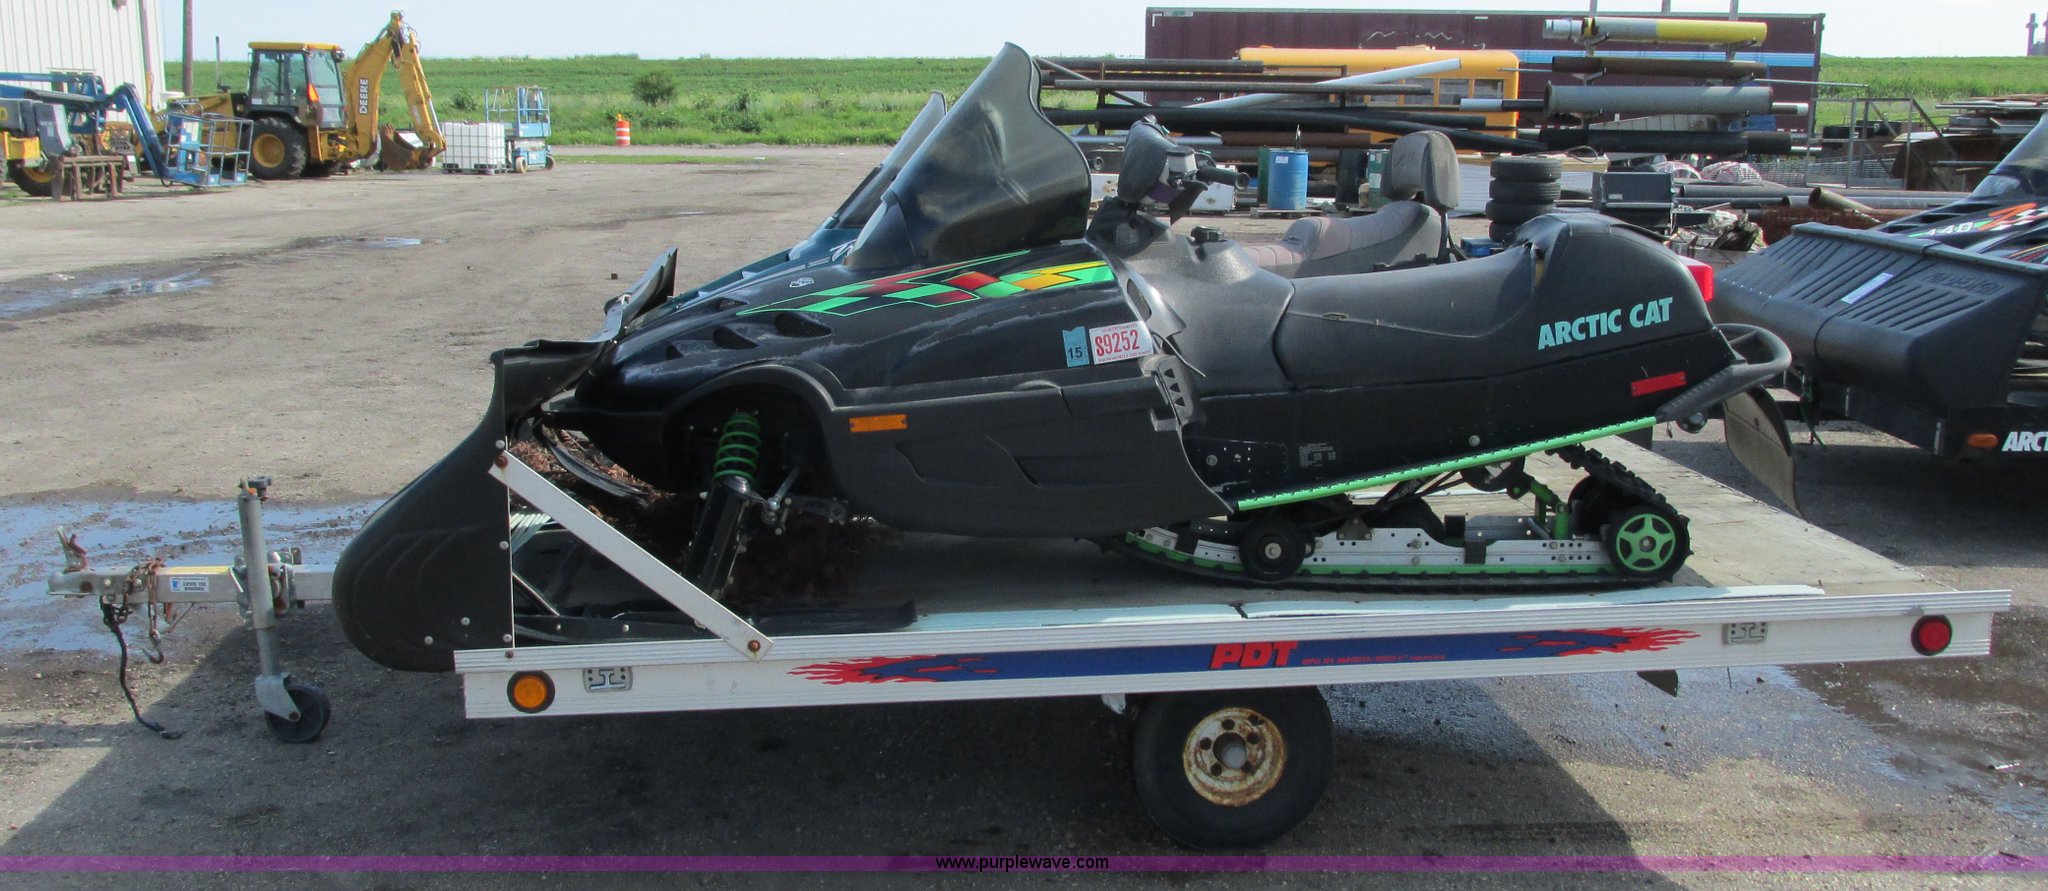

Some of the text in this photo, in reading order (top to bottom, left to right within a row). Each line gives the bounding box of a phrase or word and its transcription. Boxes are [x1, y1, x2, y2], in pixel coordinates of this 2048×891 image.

[359, 79, 369, 114] DEERE
[1538, 297, 1673, 350] ARCTIC CAT
[1067, 346, 1083, 359] 15
[1095, 329, 1140, 357] S9252
[1210, 640, 1299, 670] PDT
